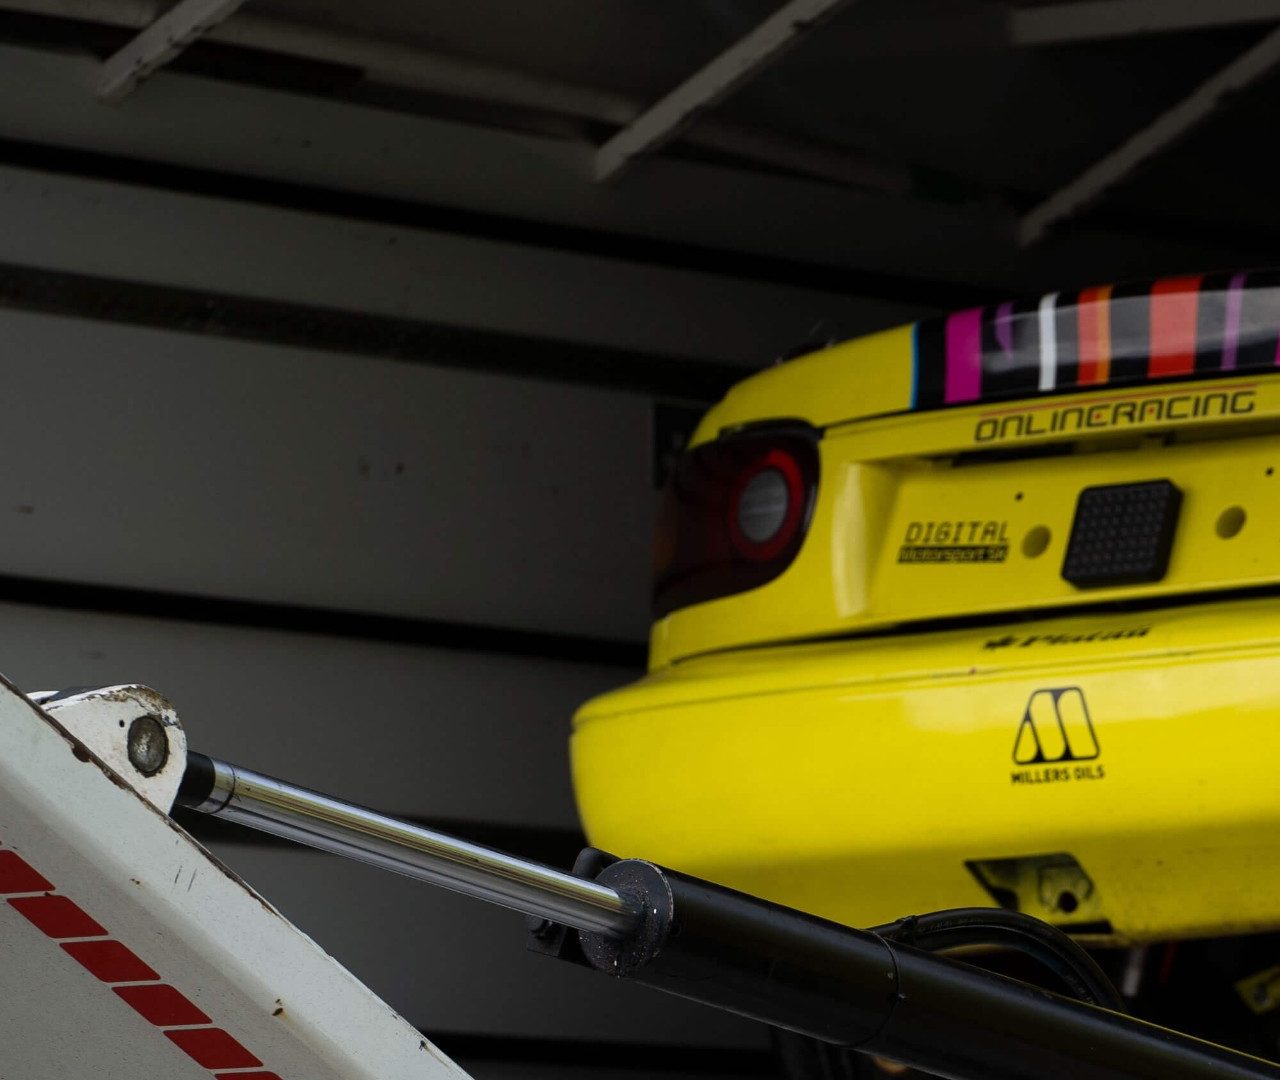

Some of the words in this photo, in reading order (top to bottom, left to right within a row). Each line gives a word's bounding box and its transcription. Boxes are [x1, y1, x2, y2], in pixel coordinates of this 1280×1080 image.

[974, 390, 1257, 443] ONLINERACING
[904, 520, 1008, 544] DIGITAL
[1011, 767, 1070, 784] MILLERS
[1074, 765, 1106, 781] OILS
